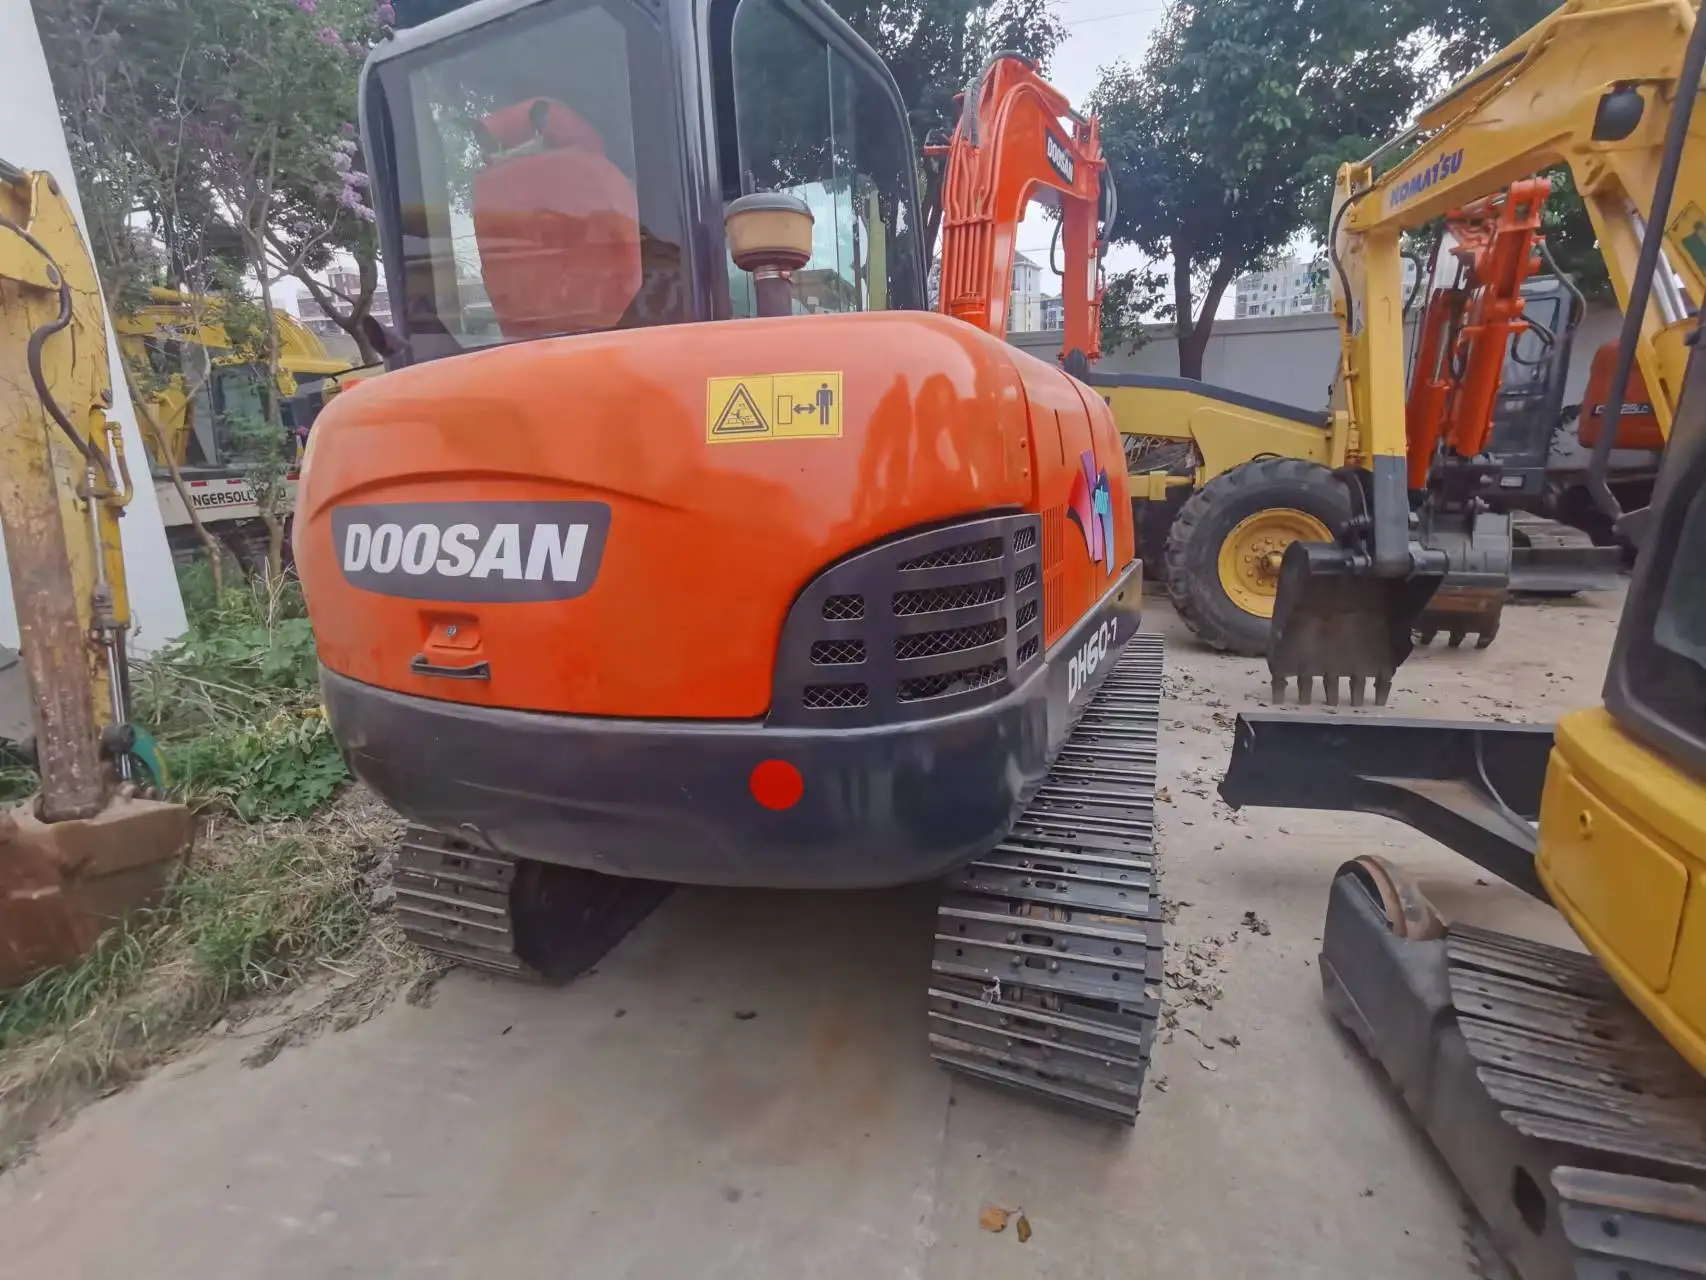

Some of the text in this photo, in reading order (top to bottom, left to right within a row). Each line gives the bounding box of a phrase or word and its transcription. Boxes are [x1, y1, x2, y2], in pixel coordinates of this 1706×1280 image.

[1389, 147, 1465, 210] KOMATSU
[344, 523, 589, 582] DOOSAN
[1068, 616, 1118, 705] DH60-7
